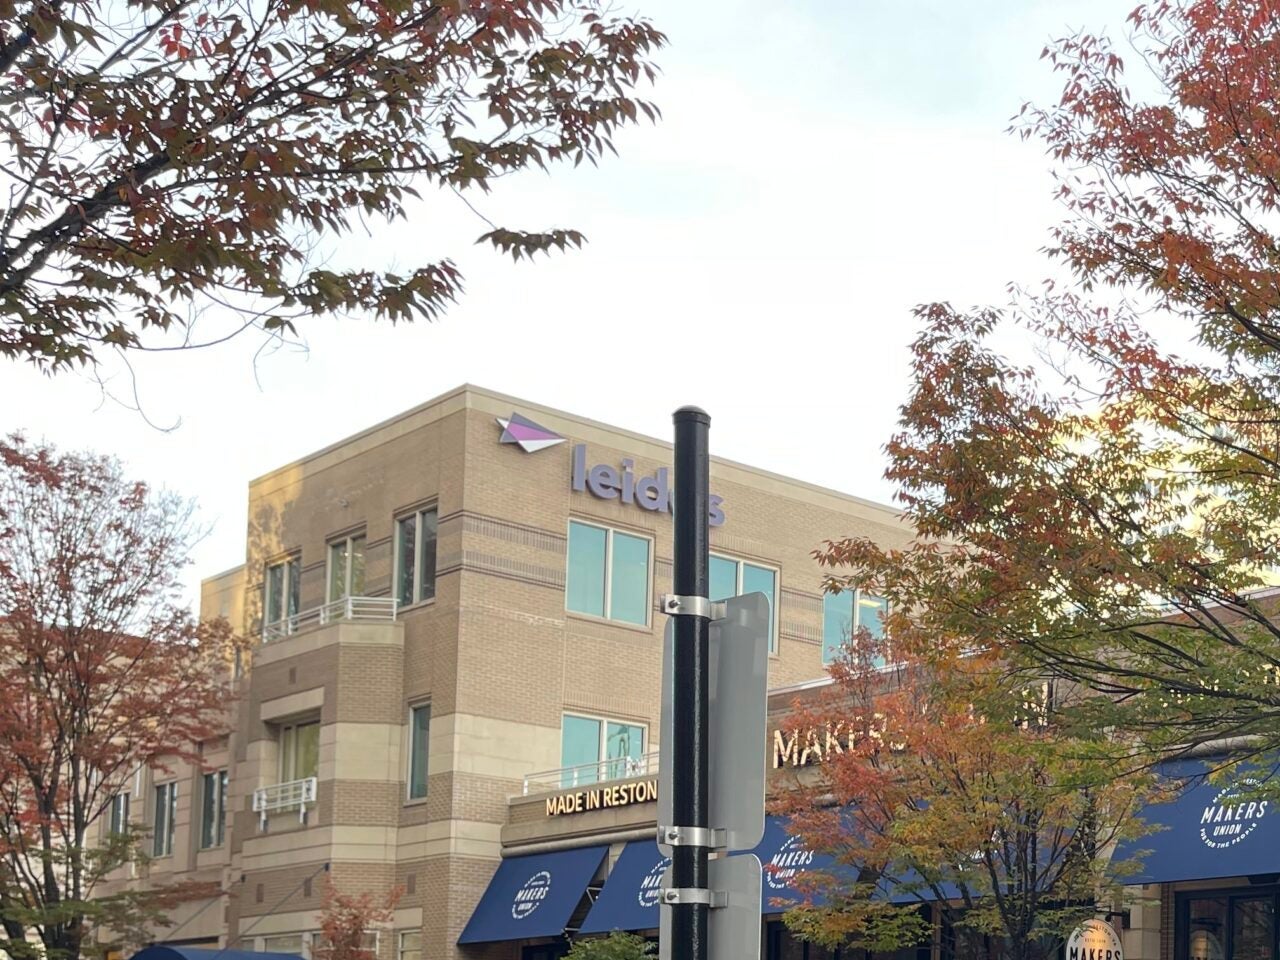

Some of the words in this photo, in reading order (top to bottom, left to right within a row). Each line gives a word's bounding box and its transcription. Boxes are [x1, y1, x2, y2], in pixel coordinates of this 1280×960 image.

[571, 443, 725, 527] leids
[546, 792, 583, 816] MADE
[585, 789, 600, 810] IN
[603, 779, 659, 807] RESTON
[1200, 801, 1268, 824] MAKERS
[1213, 824, 1242, 836] UNION
[771, 850, 815, 867] MAKERS
[514, 887, 549, 902] MAKERS
